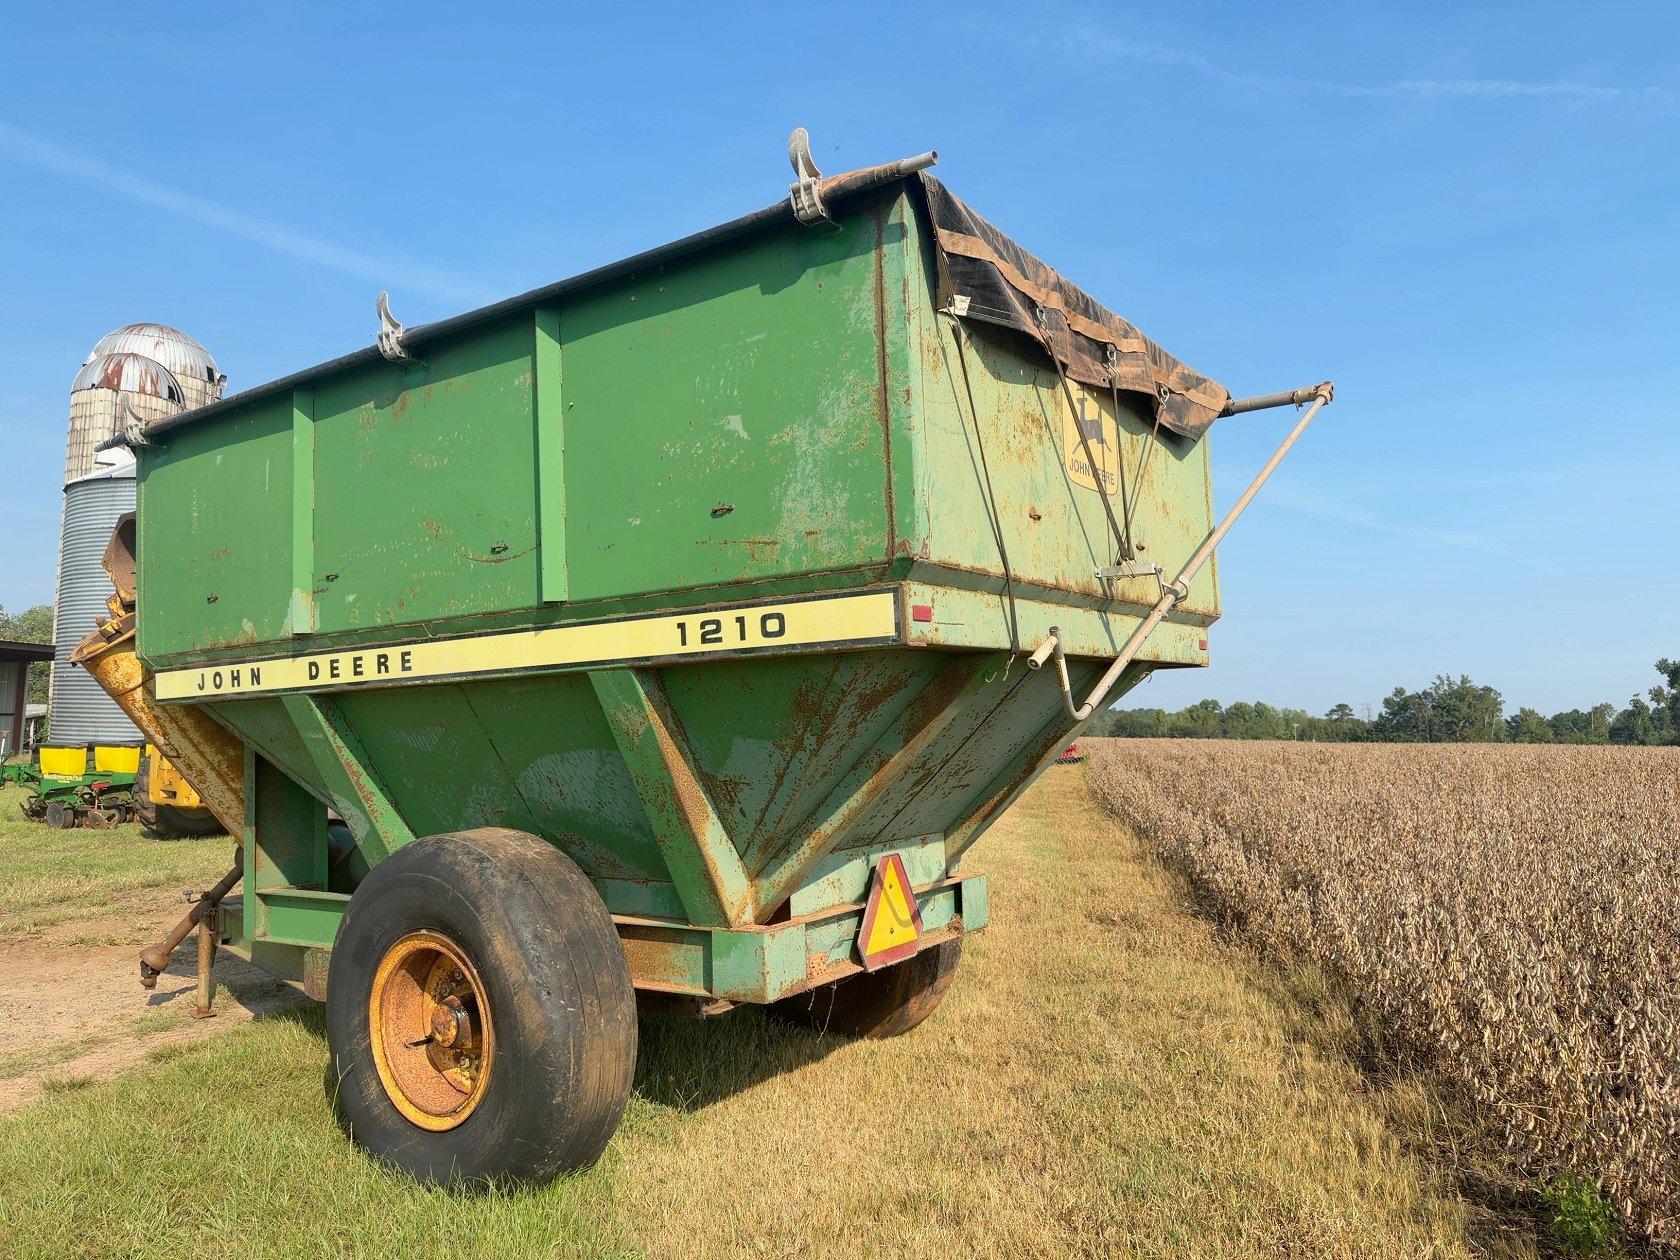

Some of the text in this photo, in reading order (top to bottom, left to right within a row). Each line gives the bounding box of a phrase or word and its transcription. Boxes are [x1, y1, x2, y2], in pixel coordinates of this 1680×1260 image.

[1069, 459, 1090, 477] JOHN
[676, 612, 786, 647] 1210
[197, 651, 412, 691] JOHN DEERE
